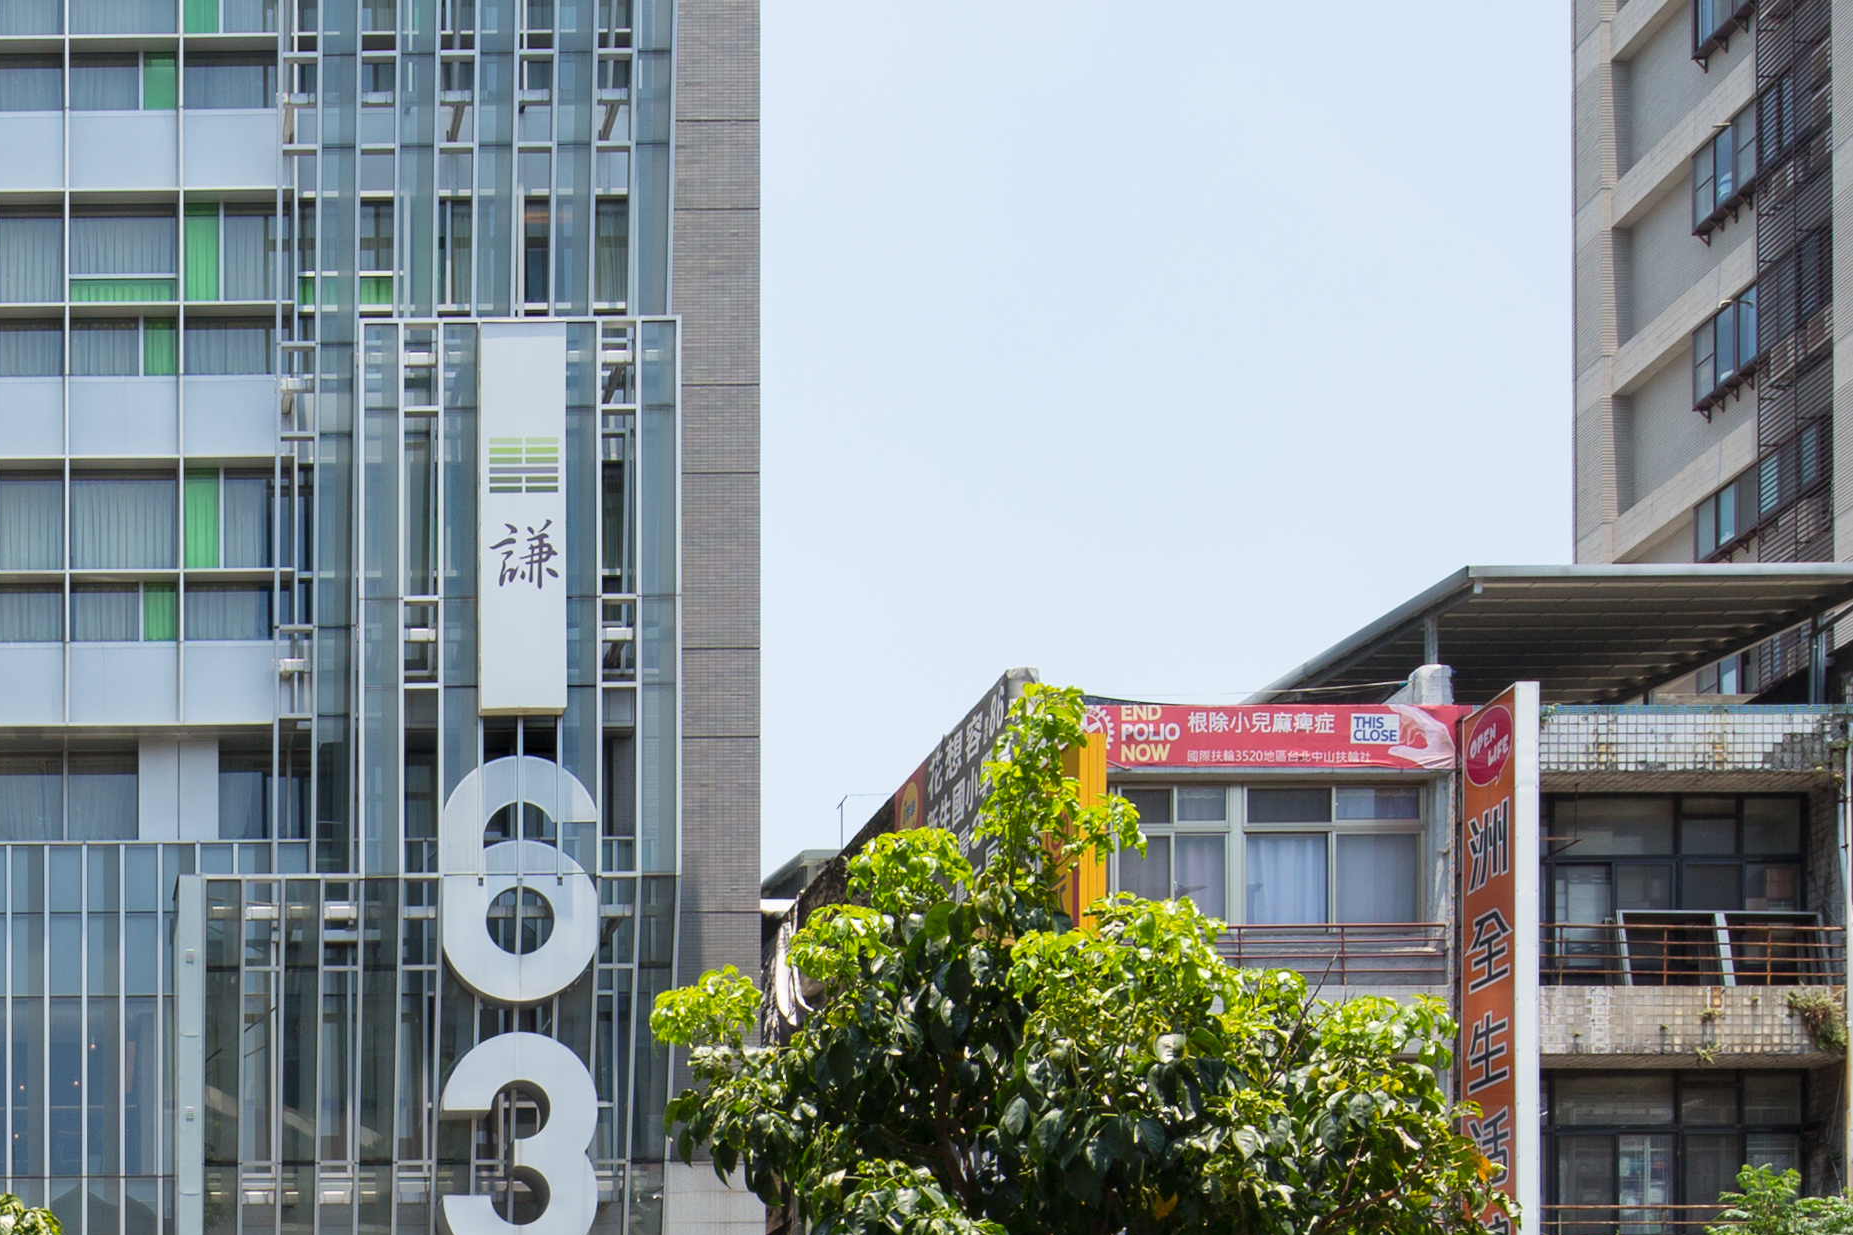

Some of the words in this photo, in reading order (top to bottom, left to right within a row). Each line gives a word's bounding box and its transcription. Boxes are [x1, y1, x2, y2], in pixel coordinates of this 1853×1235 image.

[488, 519, 560, 589] 謙
[1120, 705, 1162, 721] END
[1186, 711, 1336, 735] 根除小兒麻痺症
[1353, 716, 1385, 729] THIS
[1120, 723, 1180, 742] POLIO
[1353, 729, 1398, 742] CLOSE
[1470, 723, 1497, 760] OPEN
[1120, 743, 1171, 763] NOW
[1487, 733, 1510, 767] LIFE
